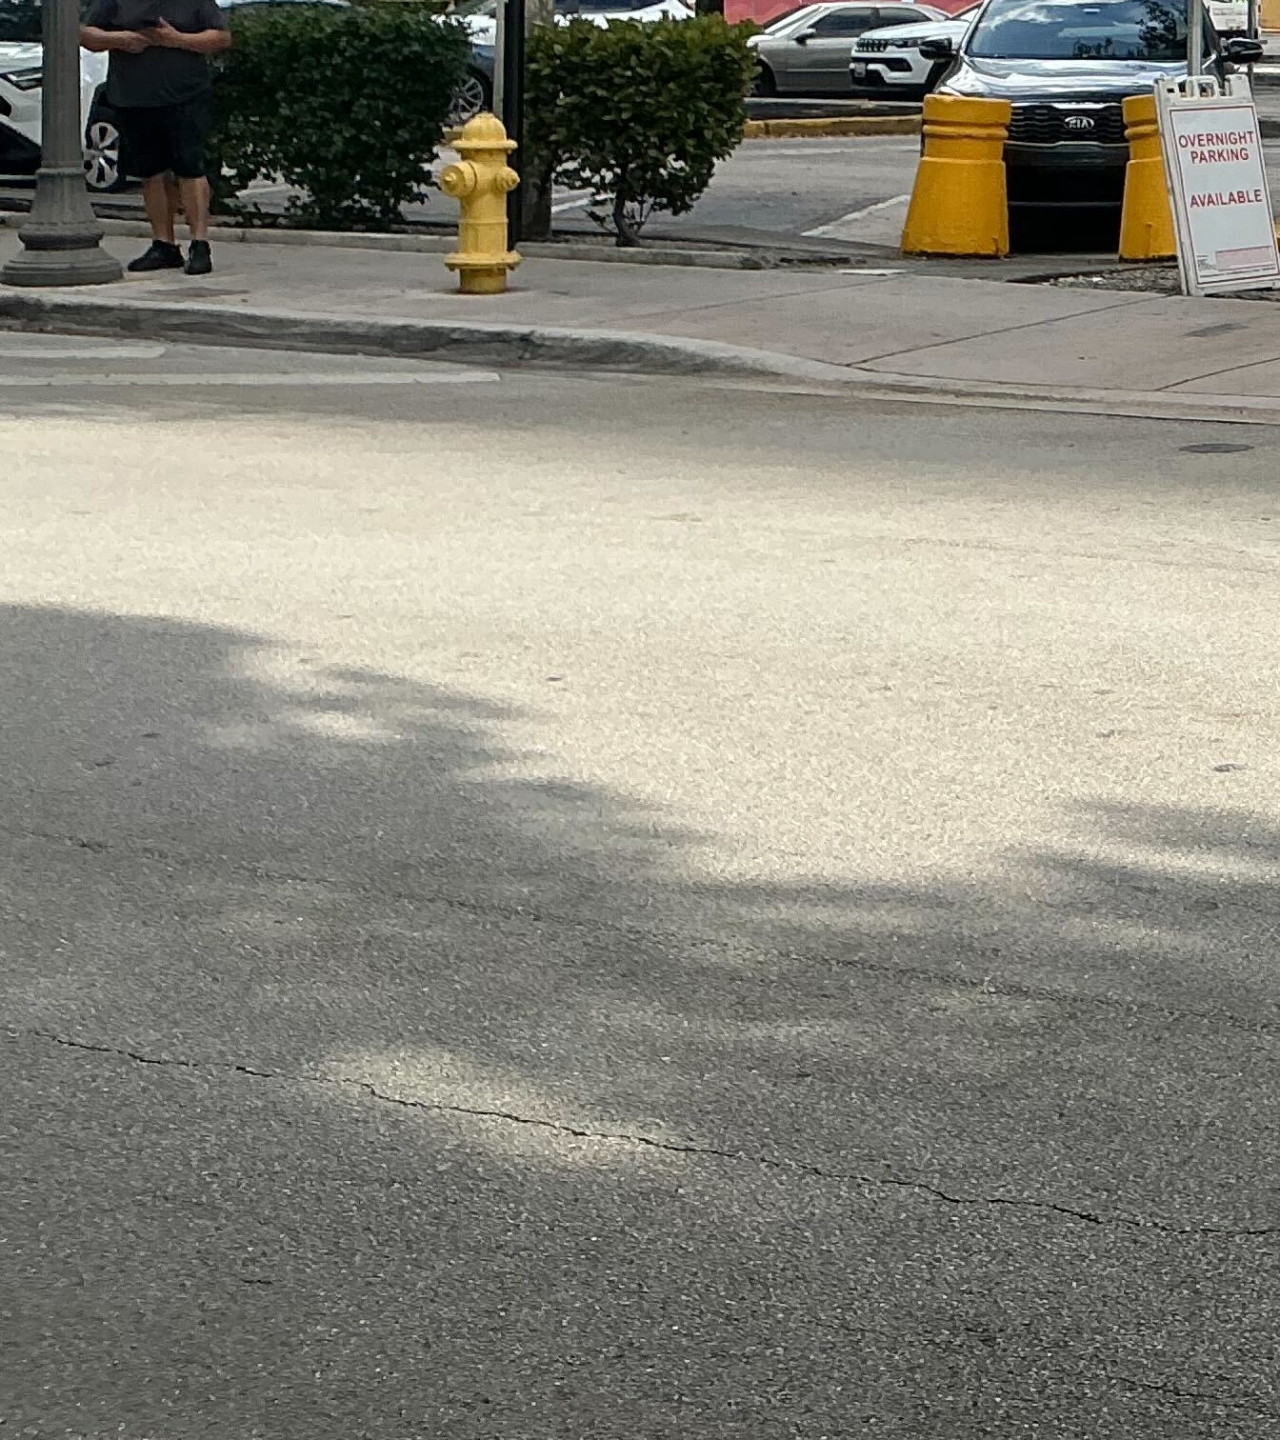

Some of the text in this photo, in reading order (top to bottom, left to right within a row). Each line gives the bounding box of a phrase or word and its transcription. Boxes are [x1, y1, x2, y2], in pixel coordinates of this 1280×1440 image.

[1178, 130, 1255, 149] OVERNIGHT
[1190, 147, 1250, 165] PARKING
[1189, 188, 1264, 209] AVAILABLE
